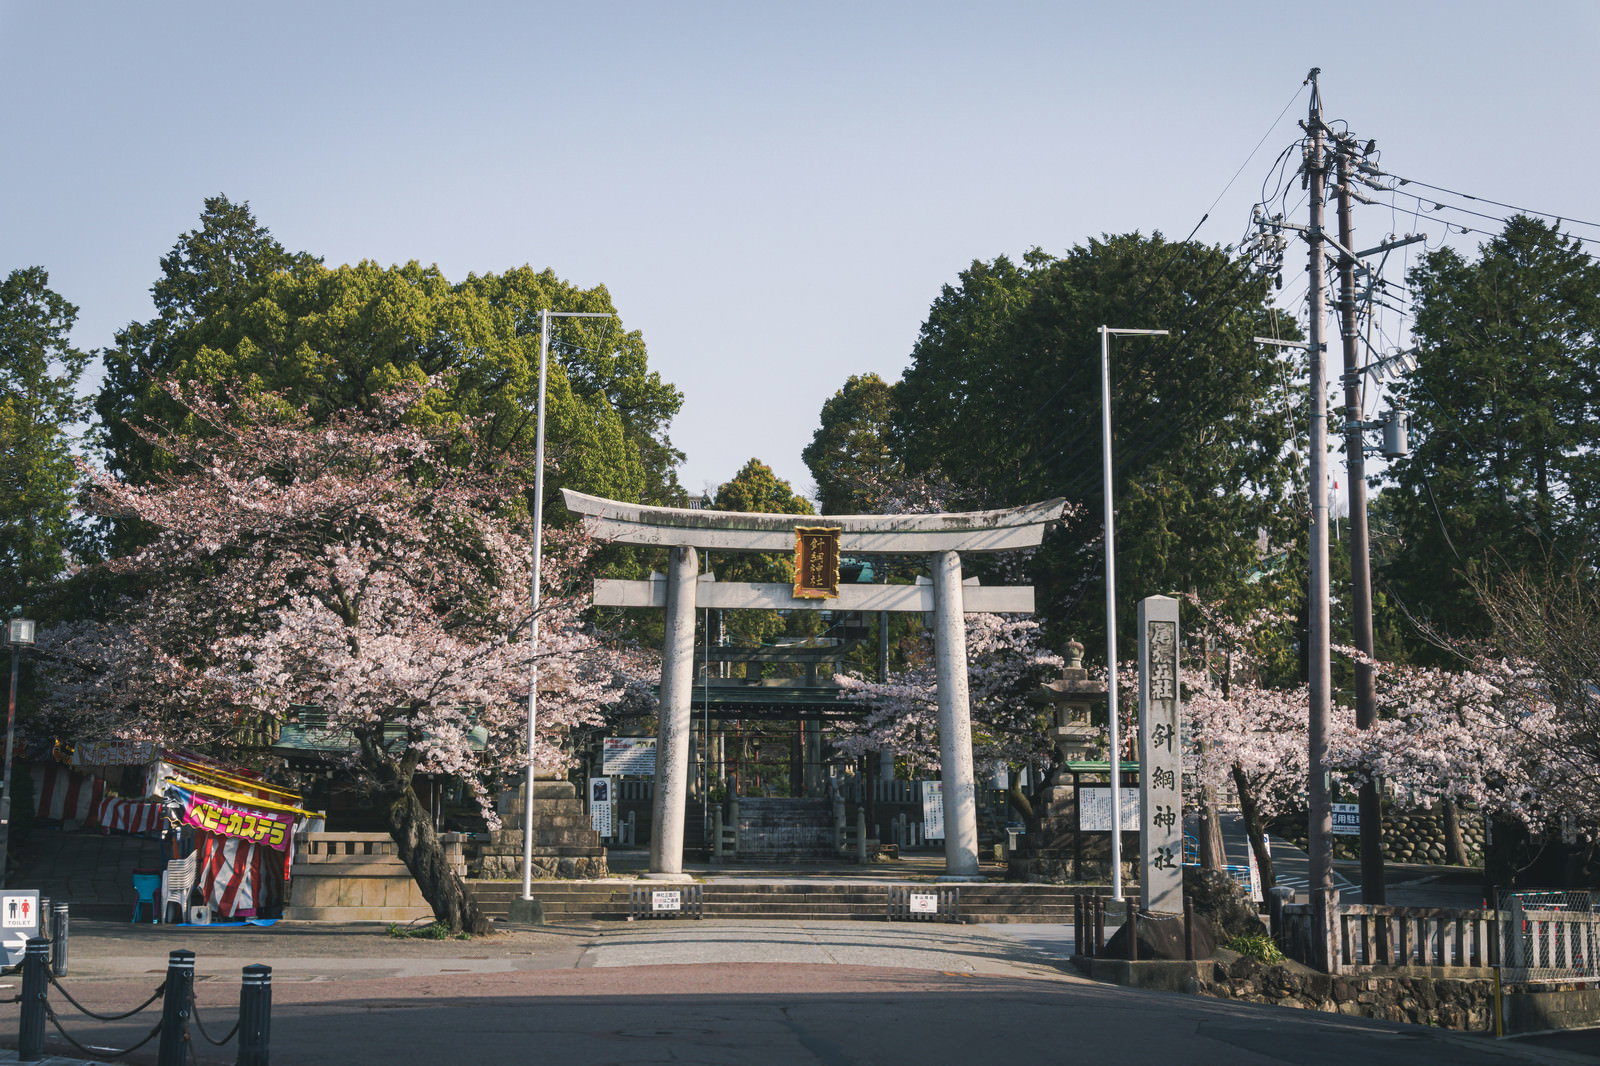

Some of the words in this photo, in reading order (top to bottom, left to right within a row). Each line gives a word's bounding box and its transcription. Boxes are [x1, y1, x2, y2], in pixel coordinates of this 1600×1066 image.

[1151, 622, 1173, 699] 尾張五社
[189, 803, 287, 845] ベビーカステラ
[1151, 723, 1177, 871] 針綱神社
